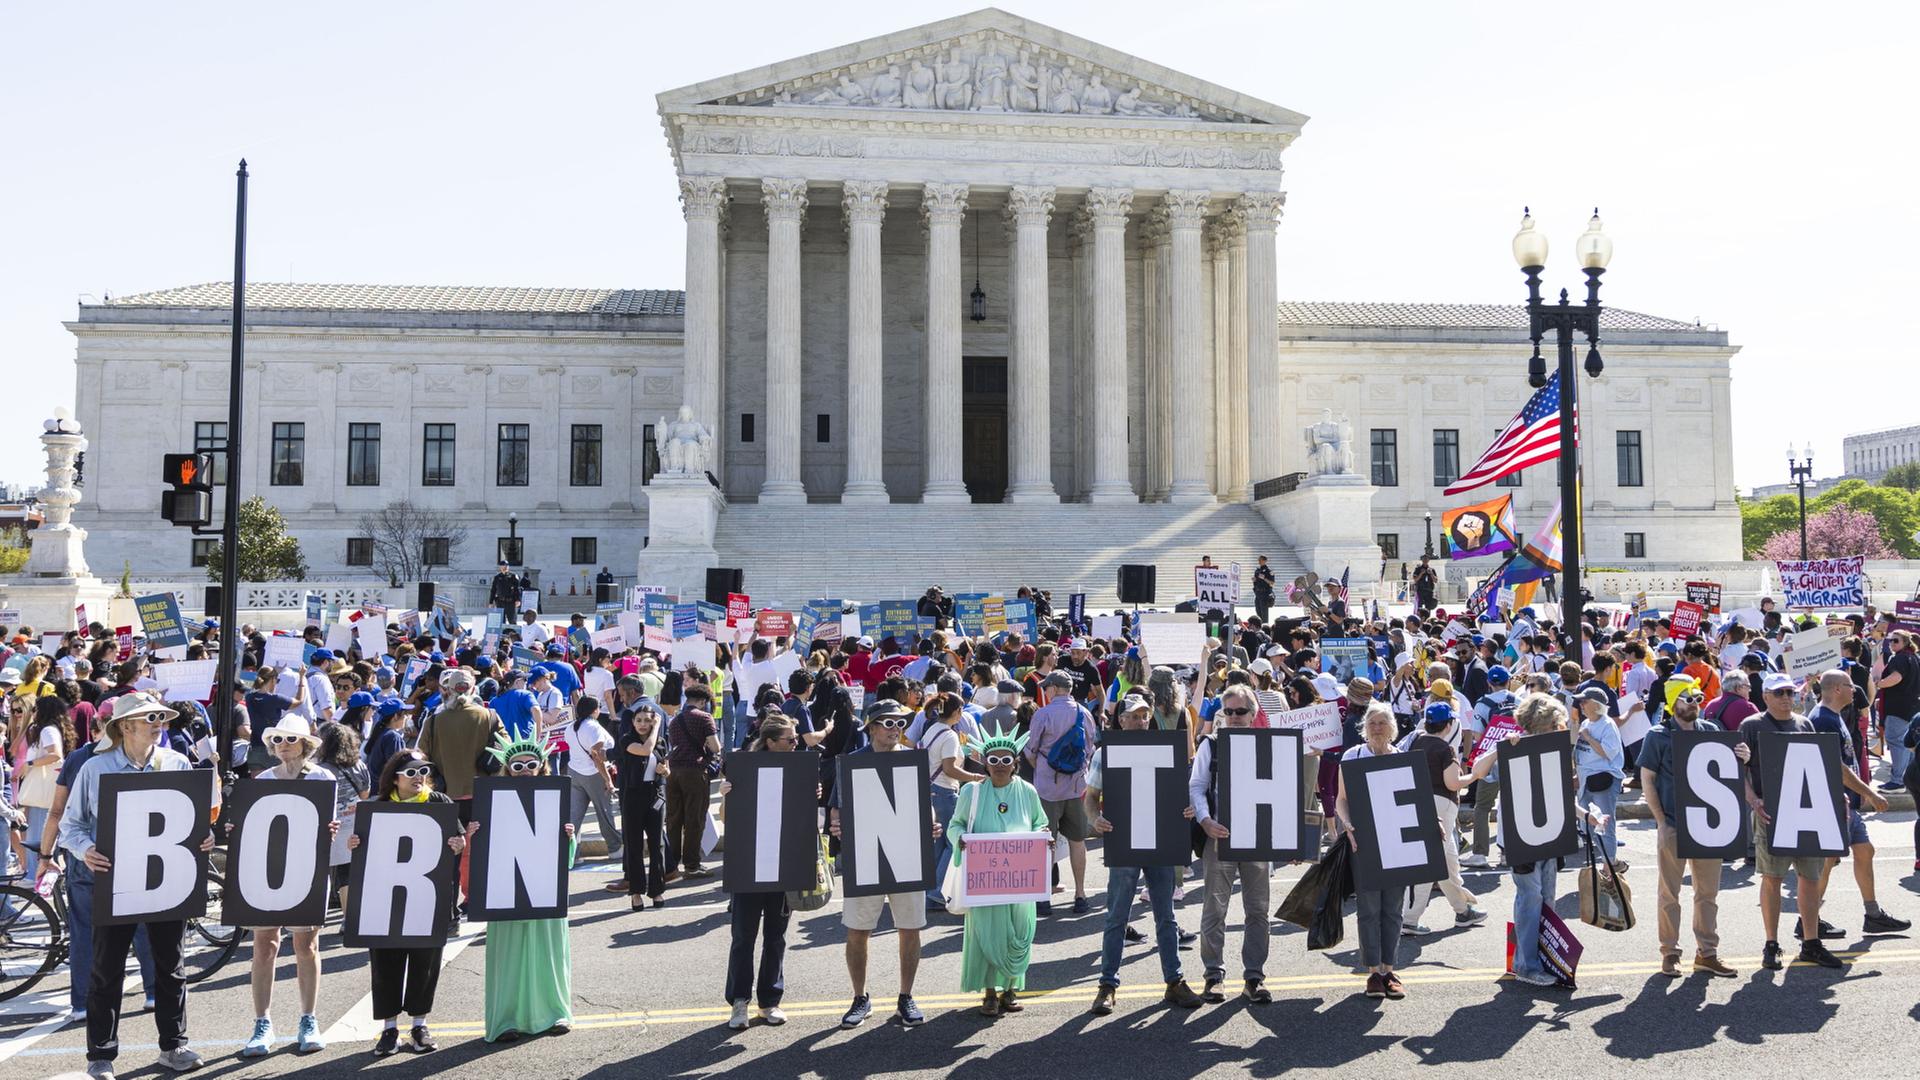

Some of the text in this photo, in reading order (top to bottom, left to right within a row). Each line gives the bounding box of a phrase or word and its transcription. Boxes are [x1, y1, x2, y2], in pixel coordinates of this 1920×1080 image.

[1200, 590, 1229, 603] ALL
[1784, 588, 1863, 608] IMMIGRANTS
[729, 600, 748, 610] BIRTH
[728, 608, 747, 618] RIGHT
[1675, 608, 1700, 621] BIRTH
[1673, 617, 1698, 630] RIGHT
[1280, 712, 1312, 727] NACIDO
[970, 840, 1033, 855] CITIZENSHIP
[989, 858, 1010, 868] IS A
[967, 869, 1038, 890] BIRTHRIGHT
[1543, 929, 1560, 949] DEFEND
